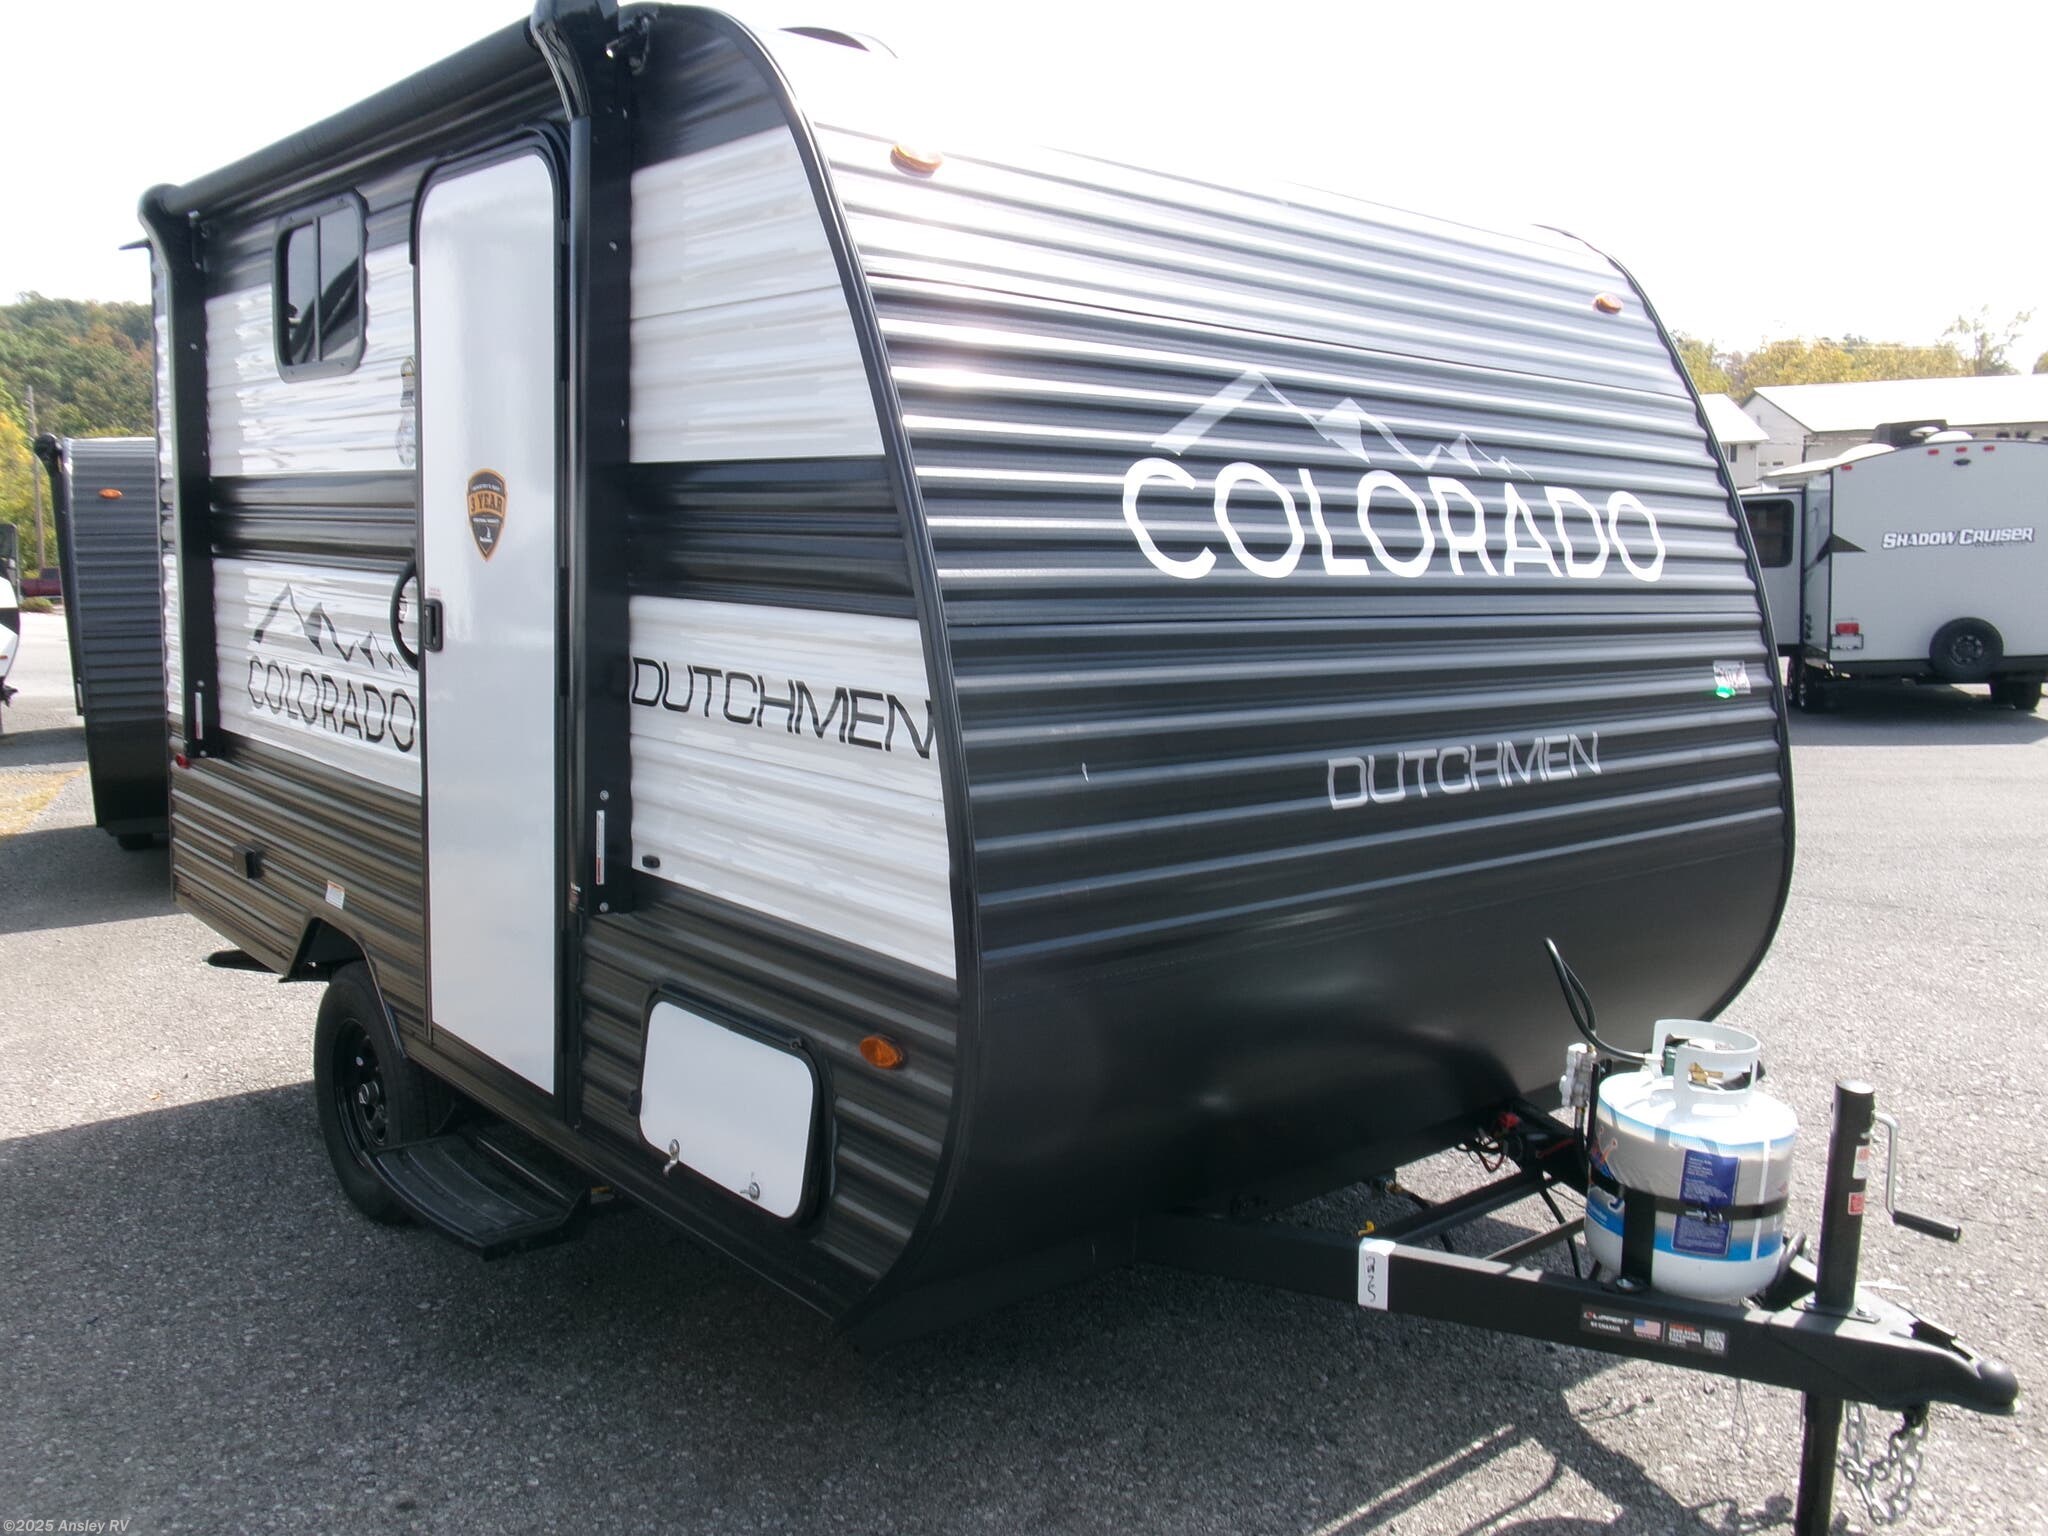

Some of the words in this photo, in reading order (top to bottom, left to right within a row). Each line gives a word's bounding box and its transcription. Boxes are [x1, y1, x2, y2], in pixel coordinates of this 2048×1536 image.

[477, 493, 503, 512] YEAR
[1122, 457, 1667, 582] COLORADO
[1882, 531, 1955, 549] SHADOW
[1958, 527, 2034, 546] CRUISER
[247, 655, 417, 753] COLORADO
[631, 656, 935, 760] DUTCHMEN
[1327, 731, 1602, 811] DUTCHMEN
